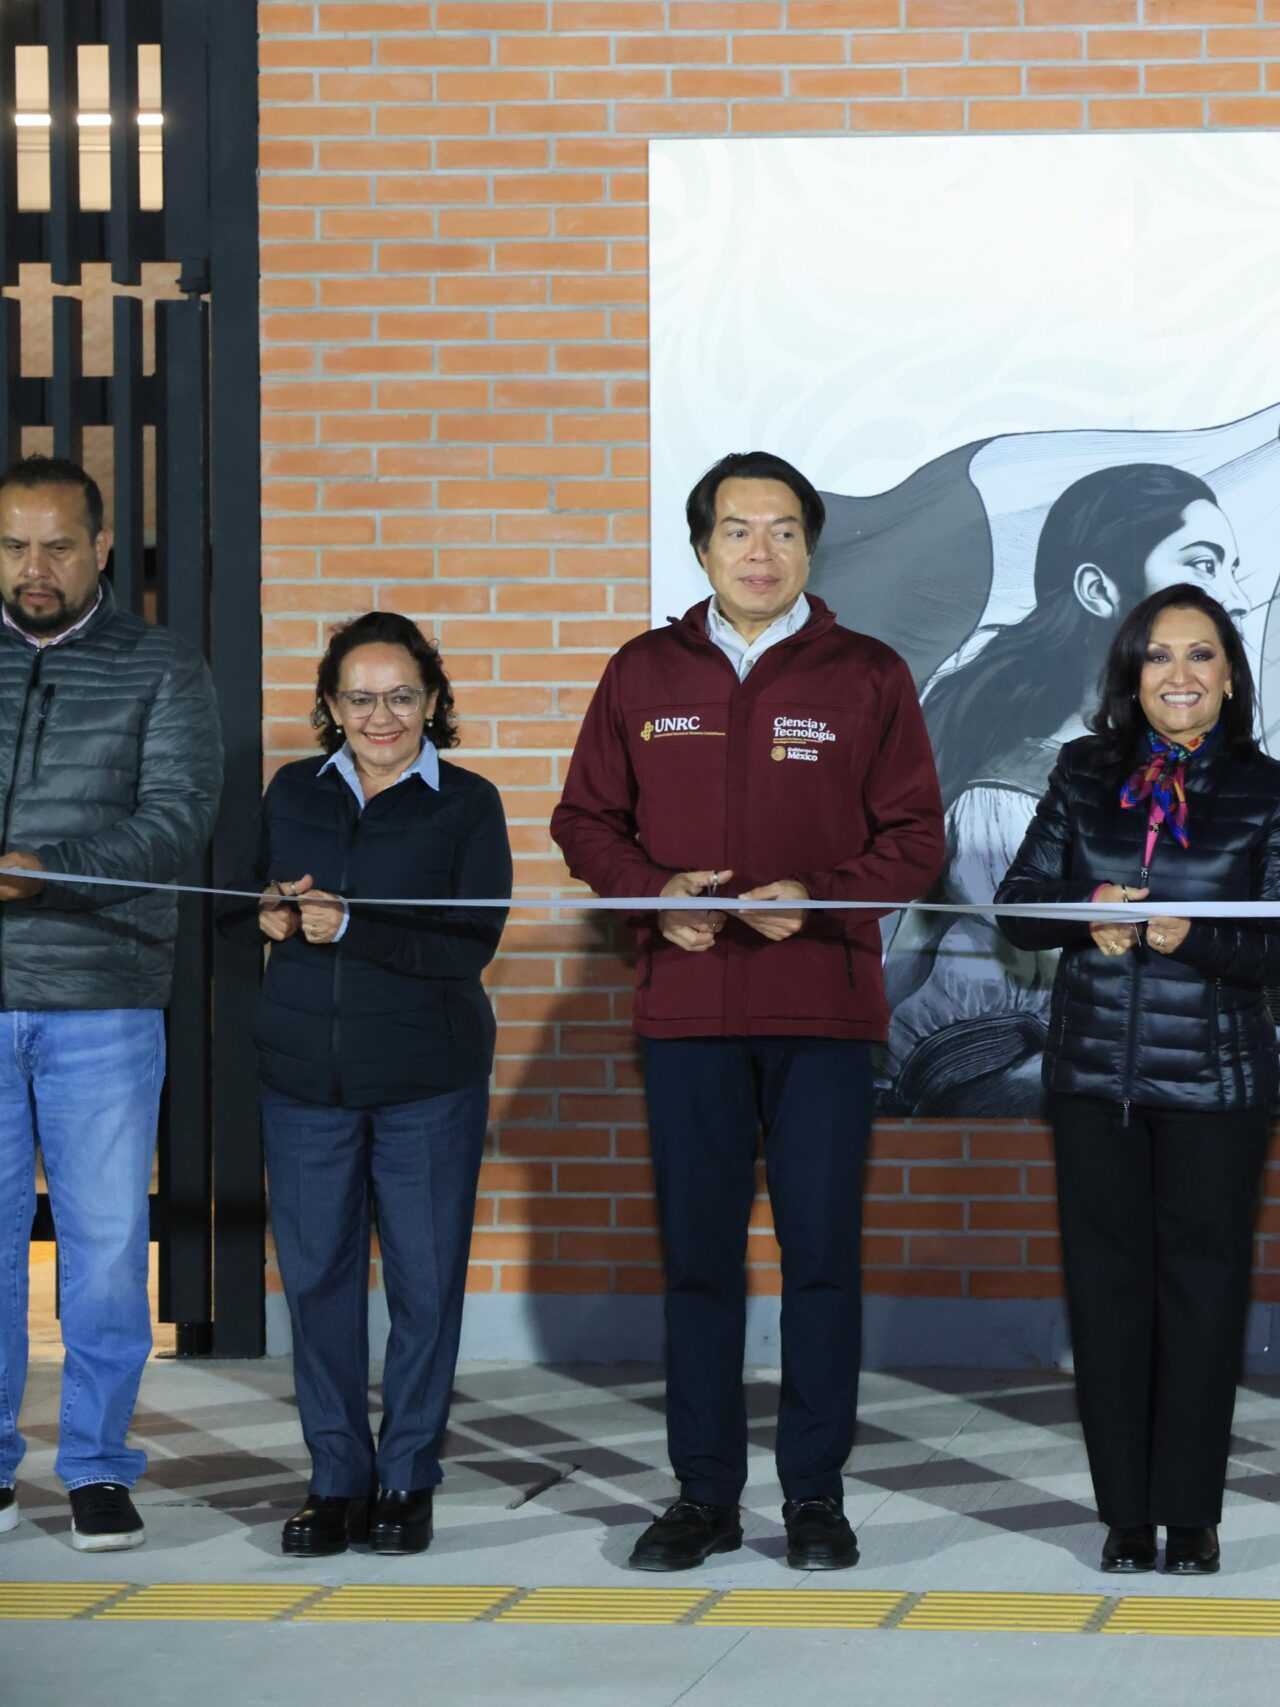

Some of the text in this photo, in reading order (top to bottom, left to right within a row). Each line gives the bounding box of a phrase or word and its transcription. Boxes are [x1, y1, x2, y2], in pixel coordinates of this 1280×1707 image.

[655, 716, 700, 732] UNRC
[774, 716, 827, 731] Ciencia y
[773, 727, 836, 741] Tecnología
[787, 751, 819, 762] México
